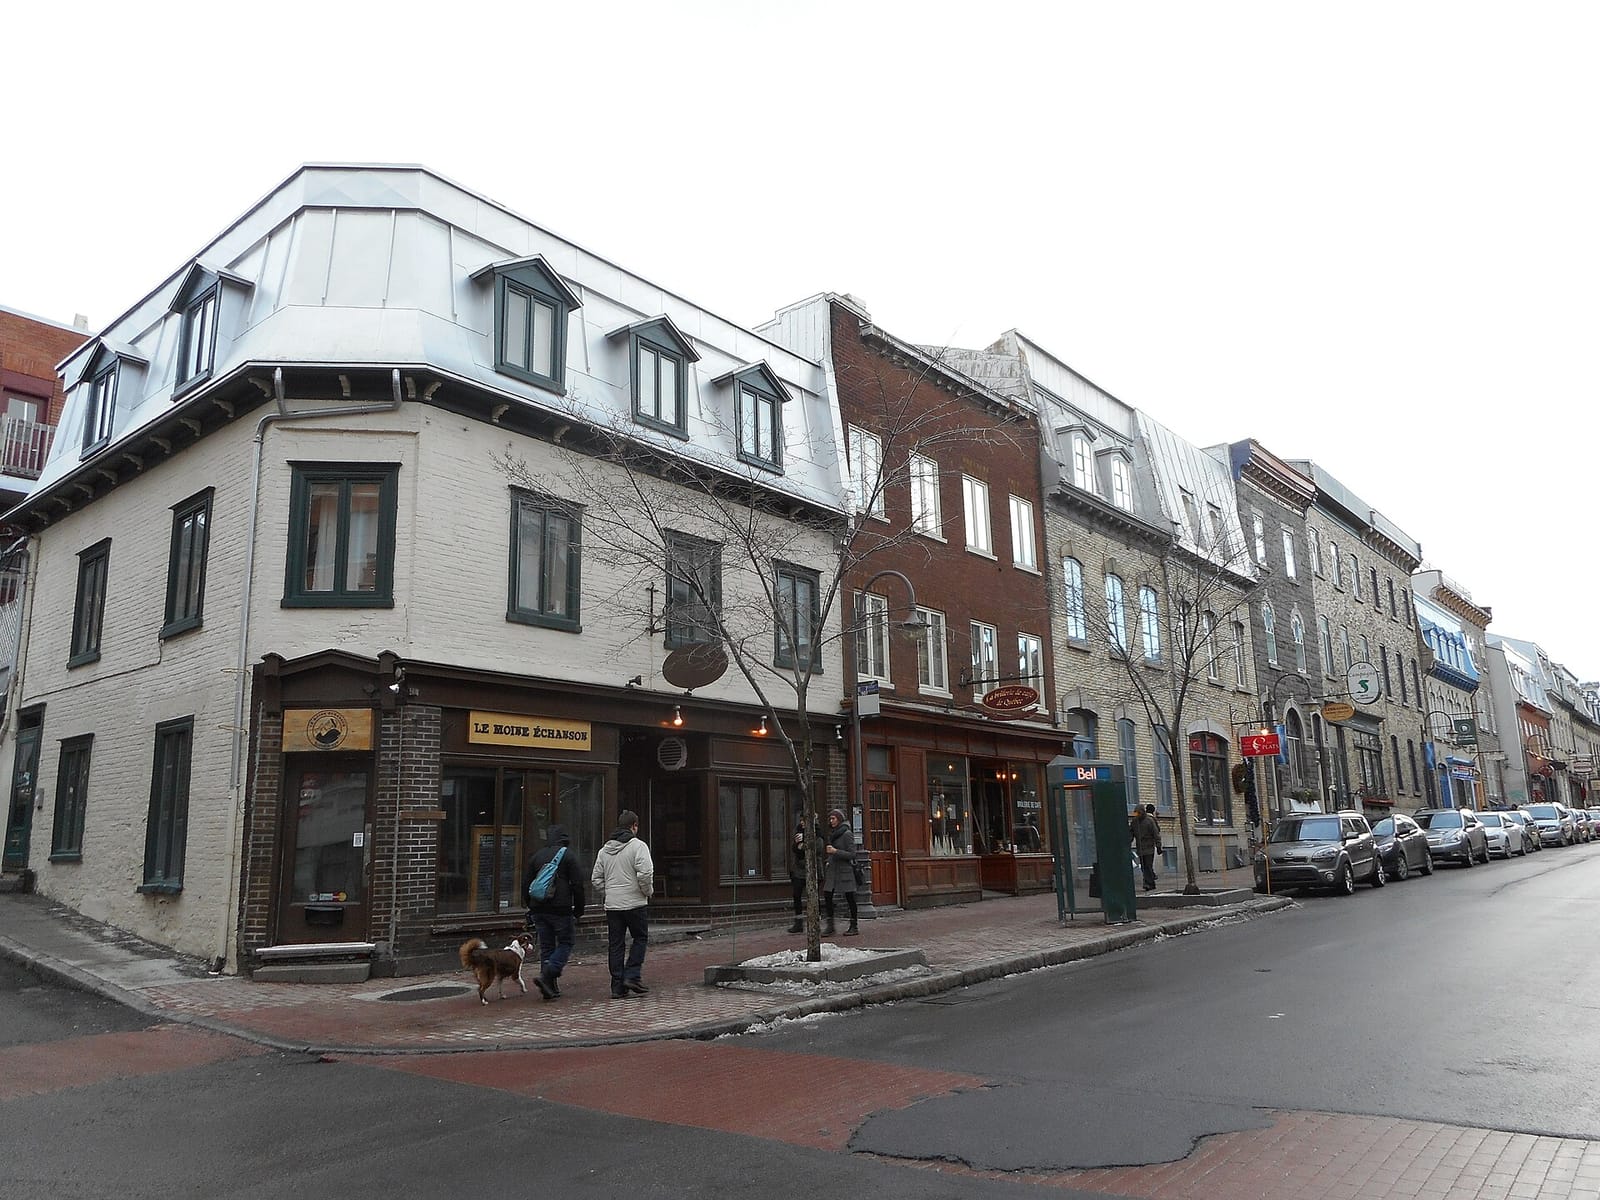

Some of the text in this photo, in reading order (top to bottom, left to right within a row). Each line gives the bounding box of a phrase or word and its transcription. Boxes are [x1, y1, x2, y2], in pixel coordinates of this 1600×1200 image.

[474, 722, 588, 741] LE MOINE ÉCHANSON
[1076, 767, 1097, 780] Bell
